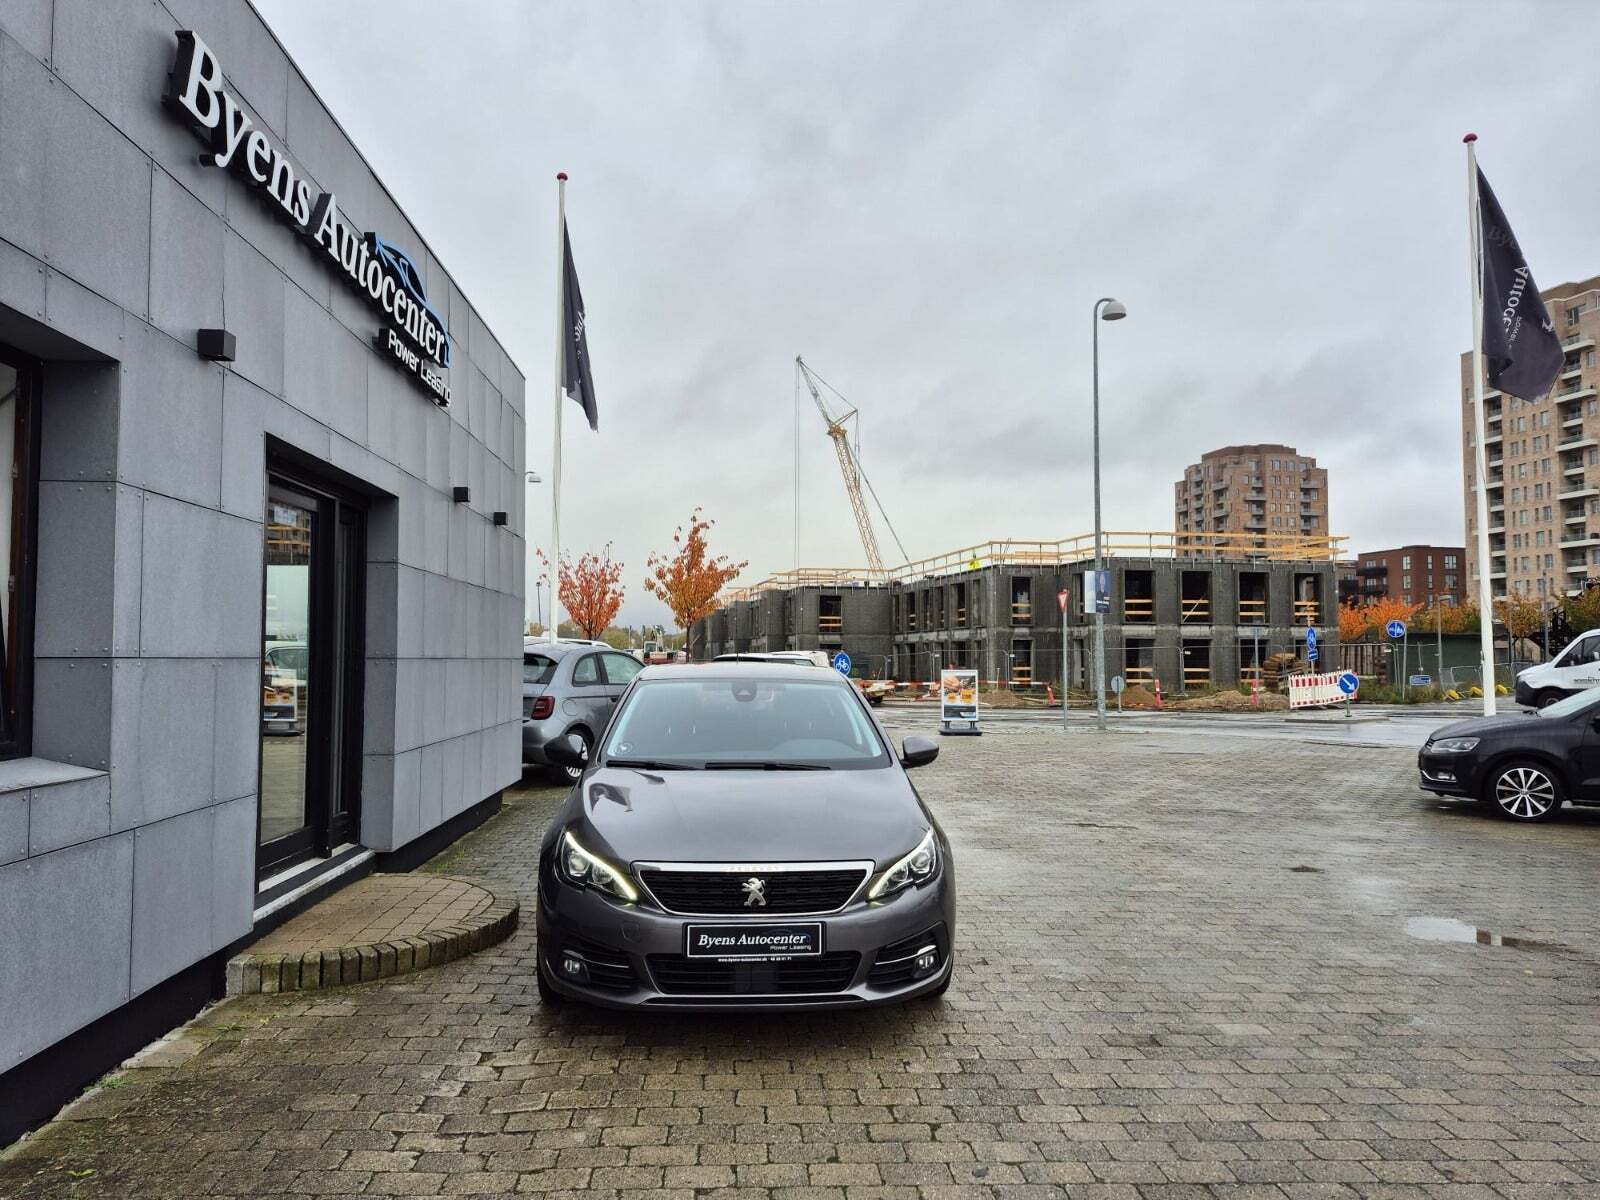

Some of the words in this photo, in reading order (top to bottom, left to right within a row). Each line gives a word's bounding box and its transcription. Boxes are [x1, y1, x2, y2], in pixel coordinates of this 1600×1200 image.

[178, 31, 311, 227] Byens
[314, 193, 445, 363] Autocenter
[388, 328, 420, 372] Power
[420, 359, 451, 407] Leasing
[698, 934, 736, 948] Byens
[737, 933, 807, 945] Autocenter
